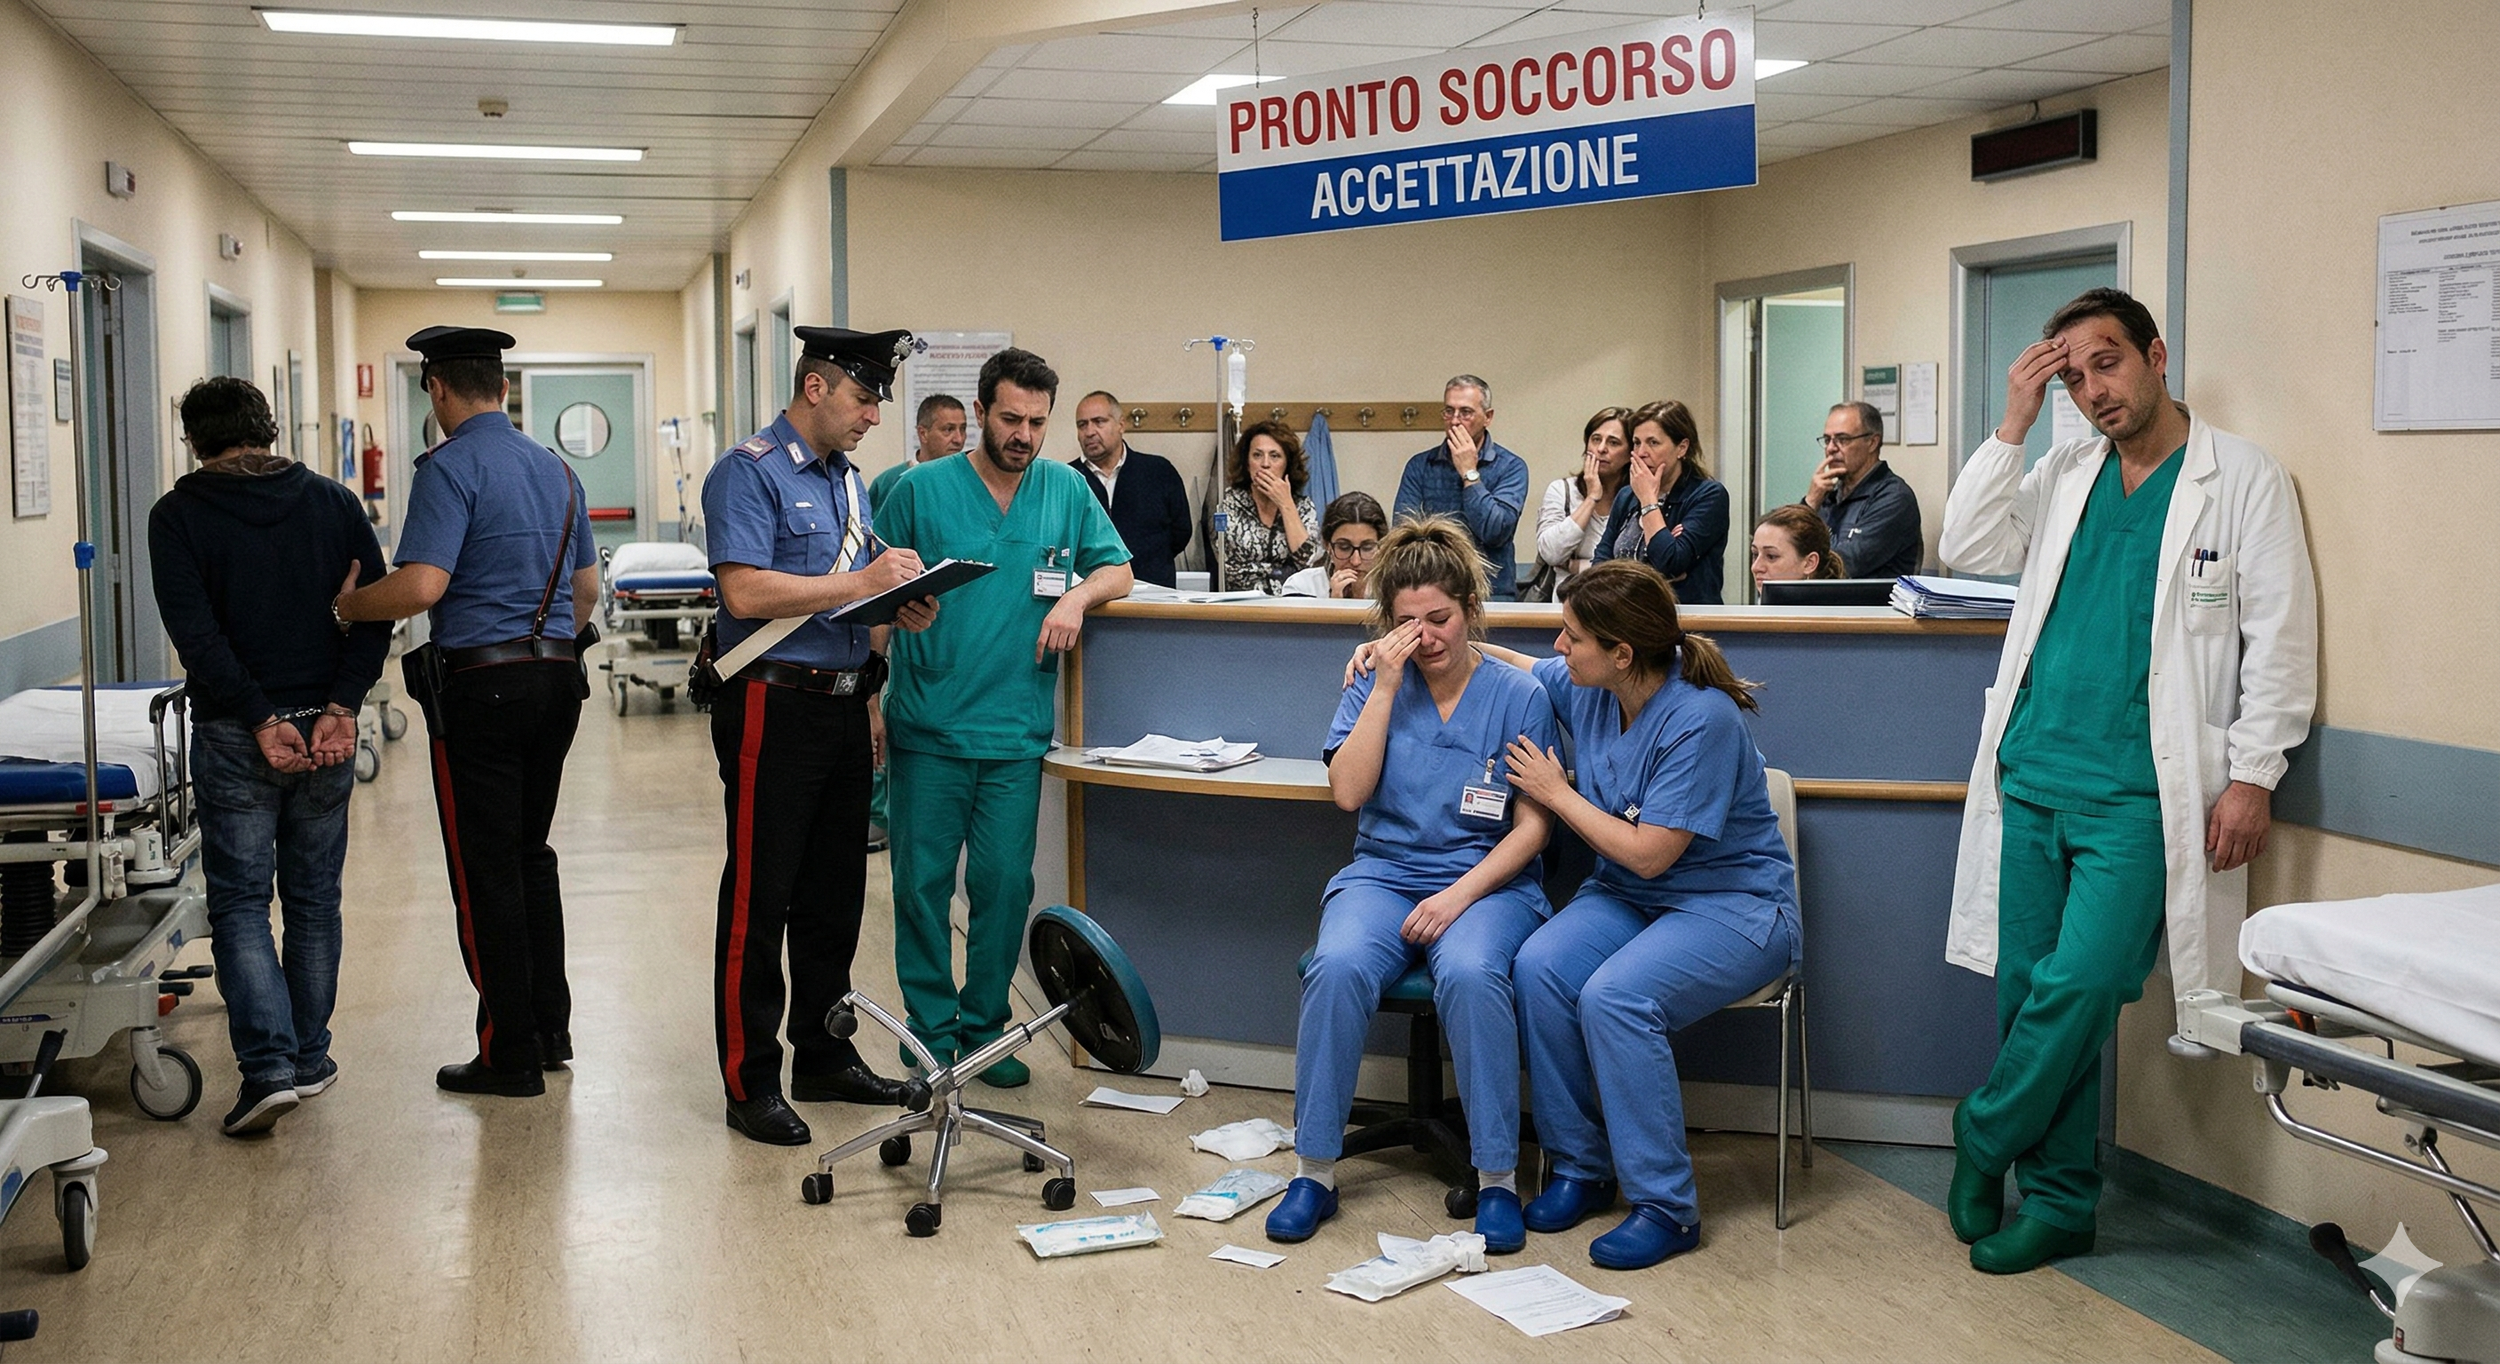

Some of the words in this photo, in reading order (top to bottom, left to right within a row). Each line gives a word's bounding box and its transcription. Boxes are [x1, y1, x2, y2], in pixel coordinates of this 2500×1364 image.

[1230, 76, 1420, 154] PRONTO
[1438, 28, 1737, 127] SOCCORSO
[1311, 133, 1639, 219] ACCETTAZIONE
